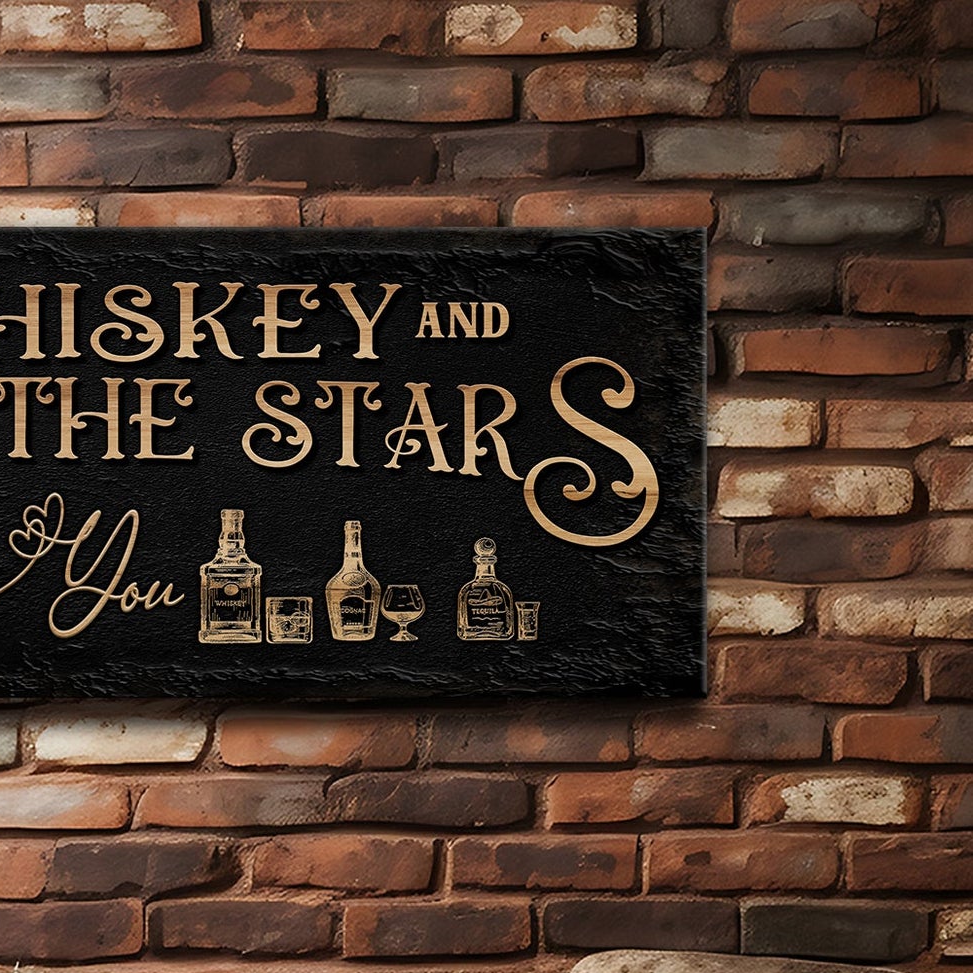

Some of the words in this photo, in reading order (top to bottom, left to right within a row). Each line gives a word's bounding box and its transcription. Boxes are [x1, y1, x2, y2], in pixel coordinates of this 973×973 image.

[414, 301, 510, 338] AND
[241, 355, 660, 547] STARS
[48, 509, 185, 638] You
